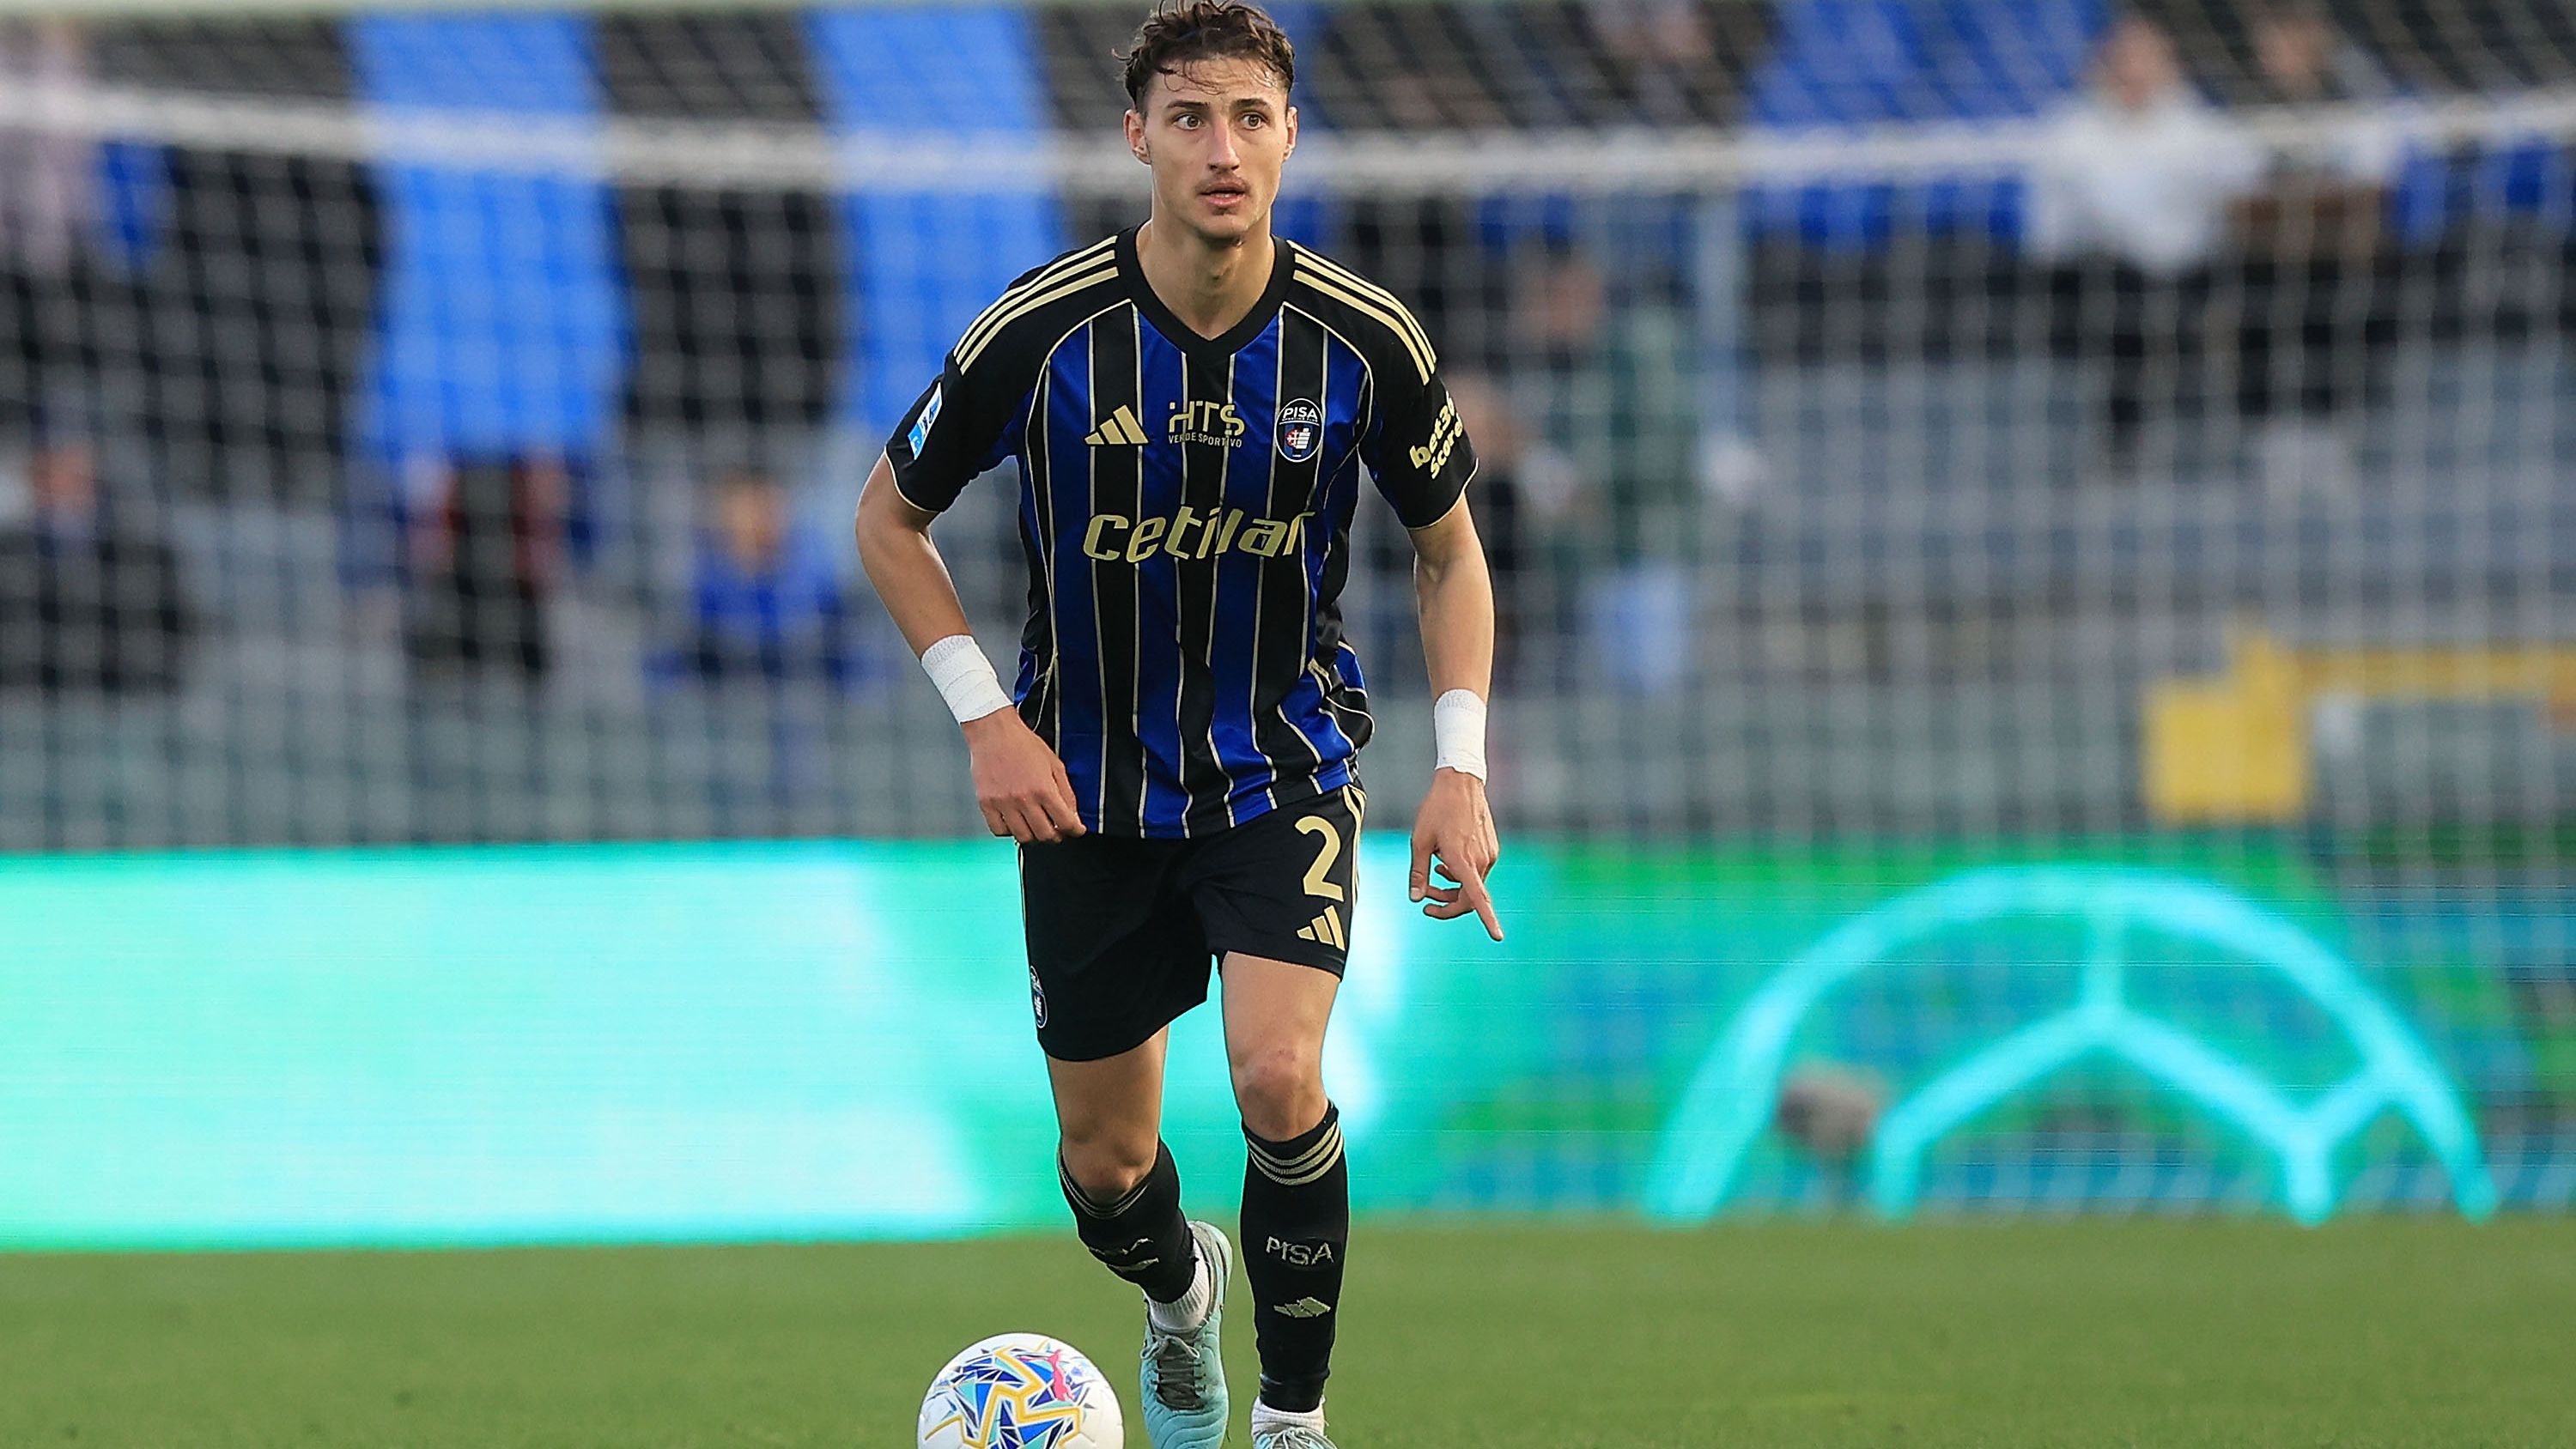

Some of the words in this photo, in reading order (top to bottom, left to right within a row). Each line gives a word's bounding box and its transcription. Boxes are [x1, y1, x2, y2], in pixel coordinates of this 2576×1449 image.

[1169, 400, 1245, 436] HTS
[1283, 406, 1318, 420] PISA
[1409, 391, 1455, 469] bet36
[1198, 433, 1242, 448] SPORTIVO
[1430, 412, 1463, 479] score
[1294, 815, 1345, 901] 2
[1266, 1236, 1334, 1264] PISA
